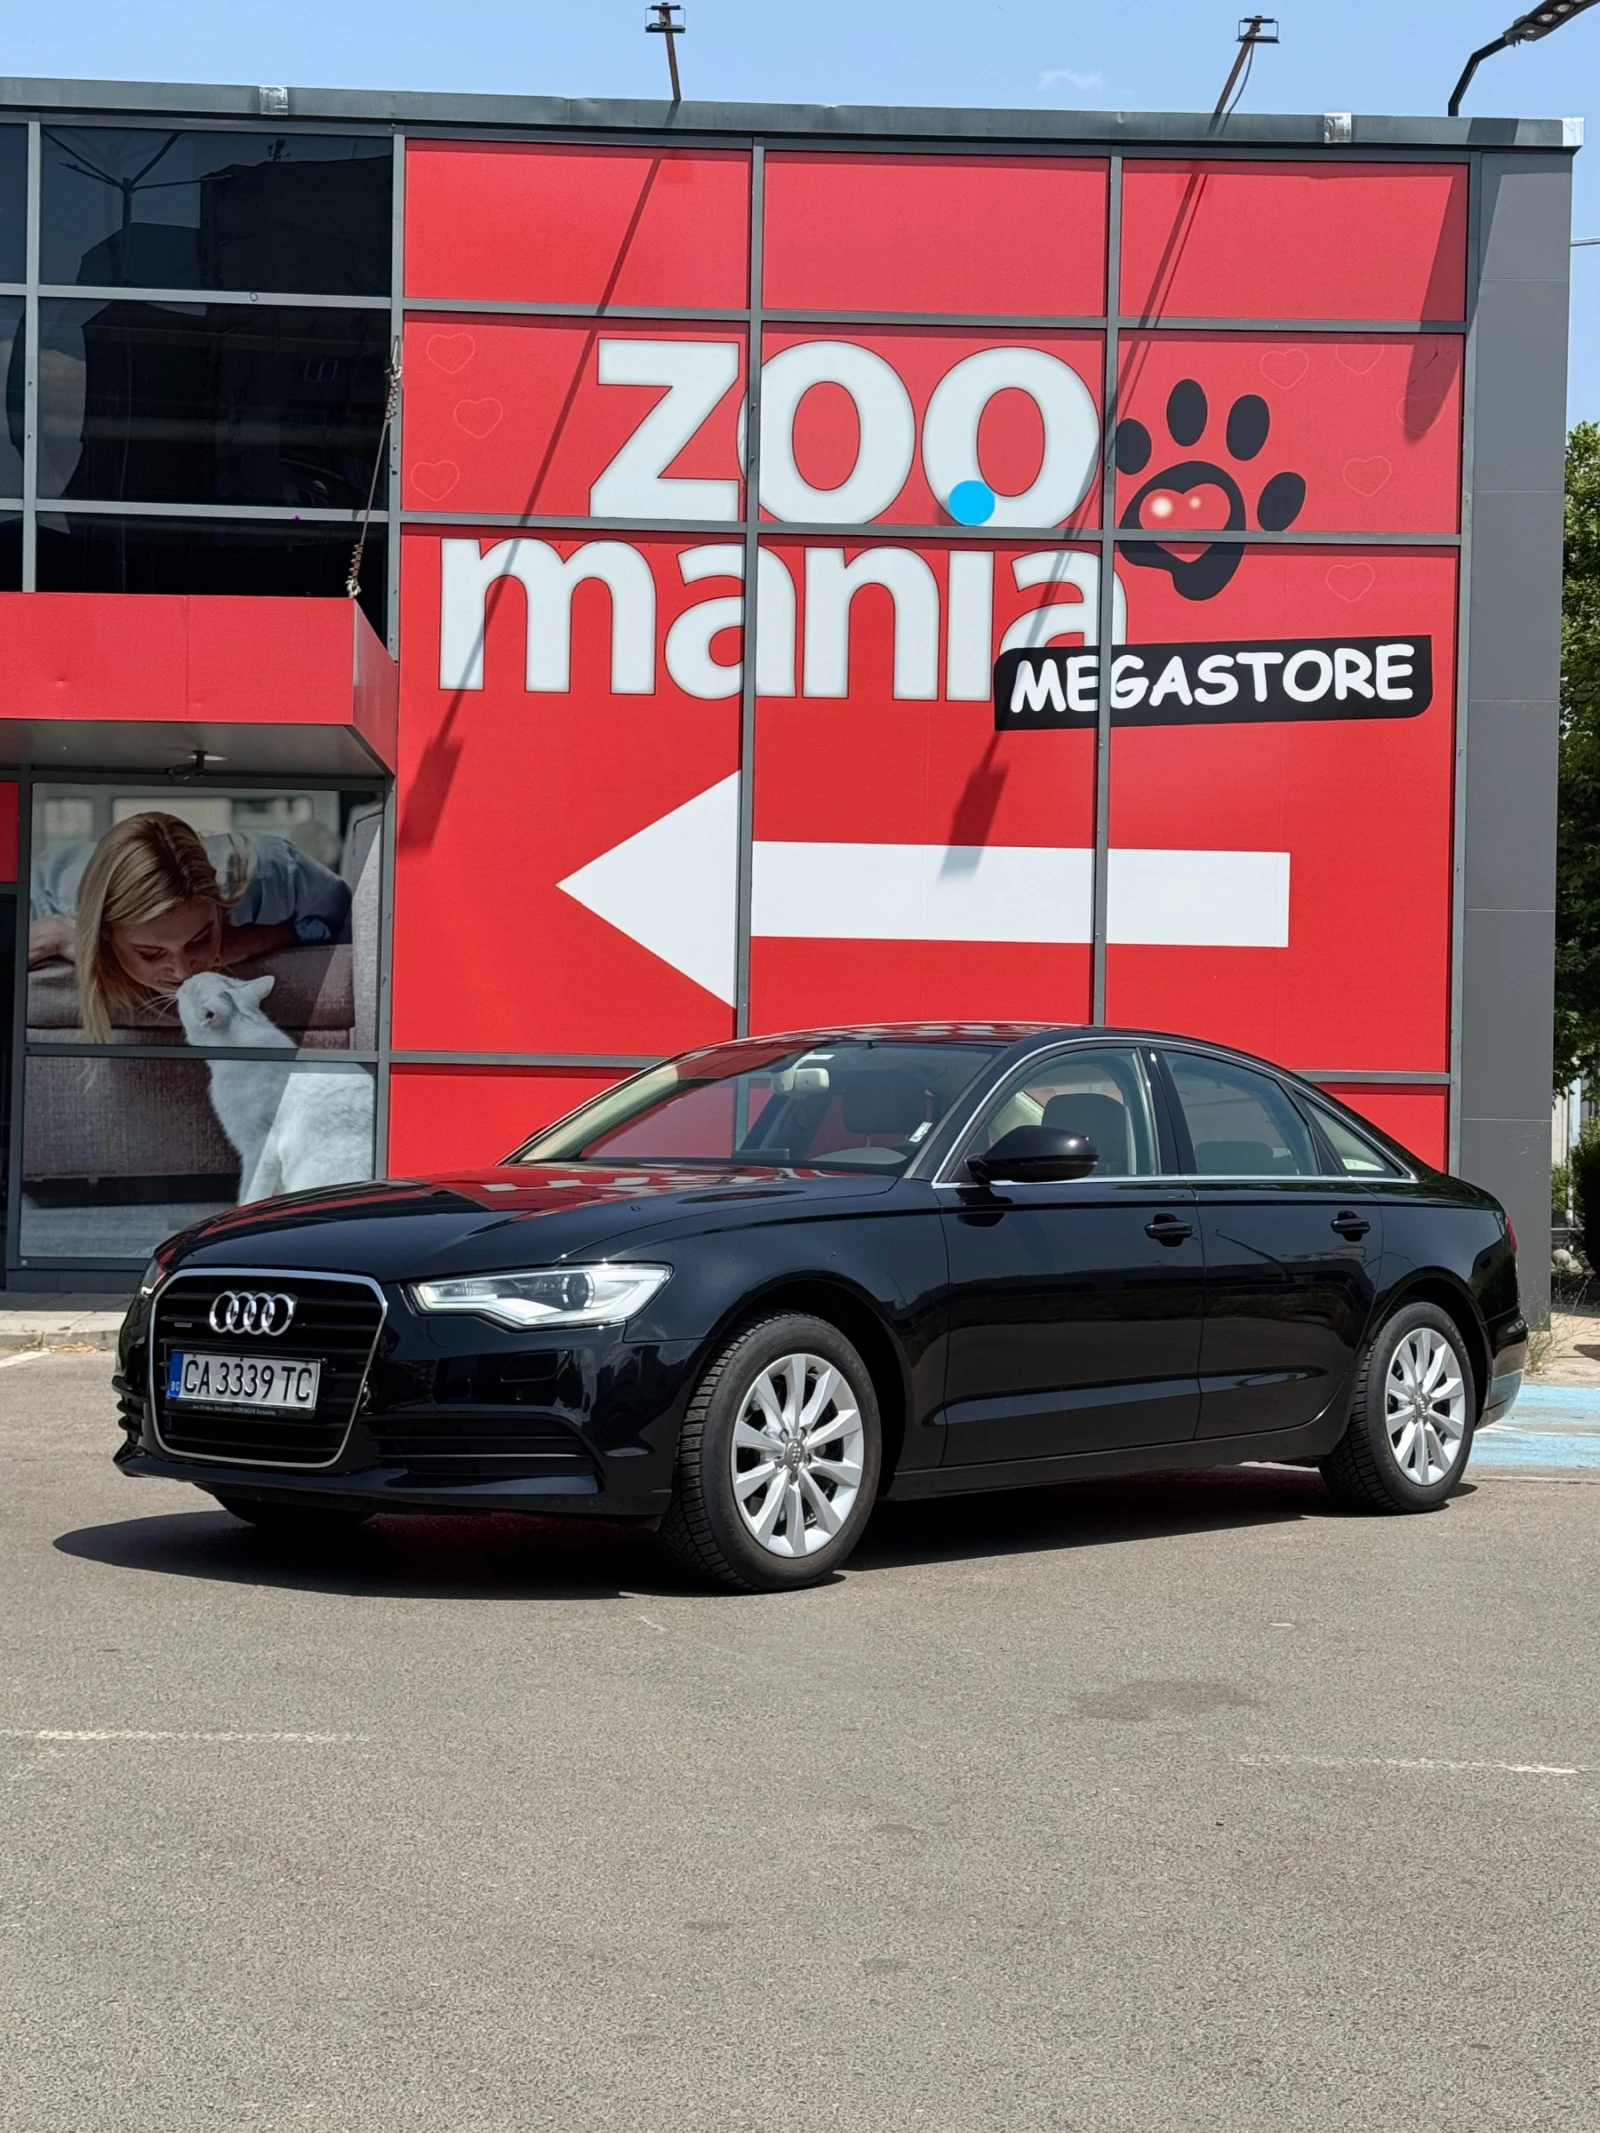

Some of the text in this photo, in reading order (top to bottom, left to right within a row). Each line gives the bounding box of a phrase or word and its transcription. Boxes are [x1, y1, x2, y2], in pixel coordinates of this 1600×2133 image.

[589, 338, 1101, 529] zoo
[438, 480, 1128, 702] mania
[1010, 643, 1415, 713] MEGASTORE
[170, 1380, 181, 1391] BG
[183, 1359, 312, 1402] CA 3339 TC
